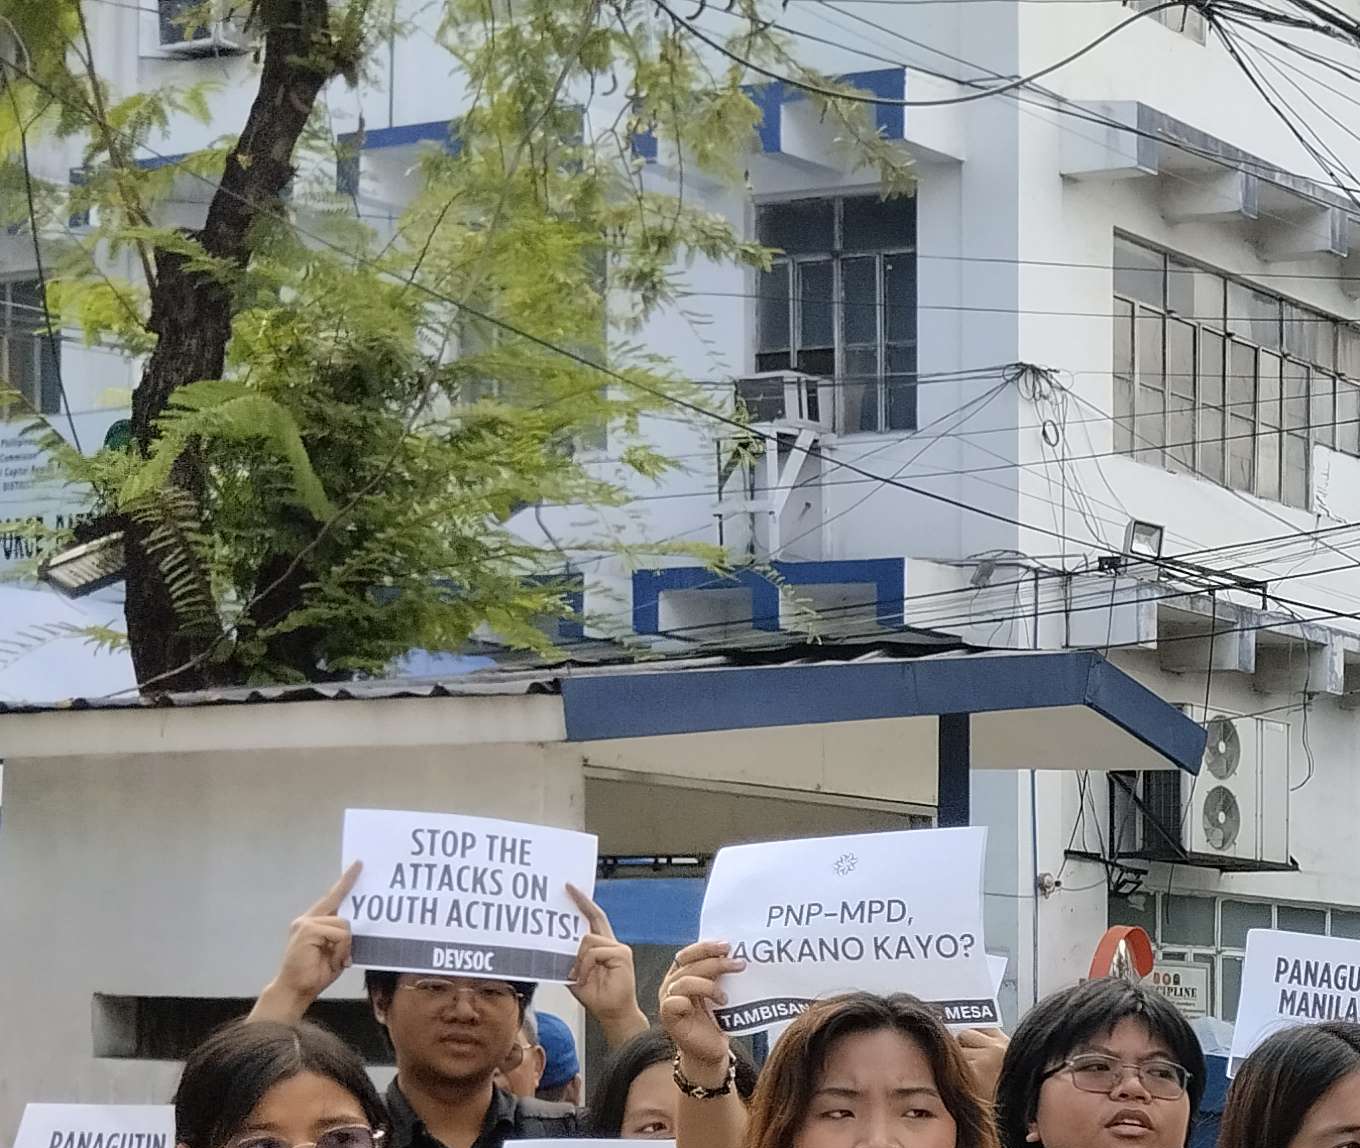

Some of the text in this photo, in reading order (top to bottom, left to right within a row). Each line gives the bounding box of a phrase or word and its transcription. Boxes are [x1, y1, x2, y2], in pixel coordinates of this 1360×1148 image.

[411, 828, 532, 866] STOP THE
[390, 862, 547, 902] ATTACKS ON
[351, 895, 580, 941] YOUTH ACTIVISTS!
[766, 900, 913, 927] PNP-MPD,
[432, 948, 493, 971] DEVSOC
[732, 933, 976, 964] AGKANO KAYO?
[945, 1005, 994, 1021] MESA
[1279, 989, 1358, 1022] MANILA
